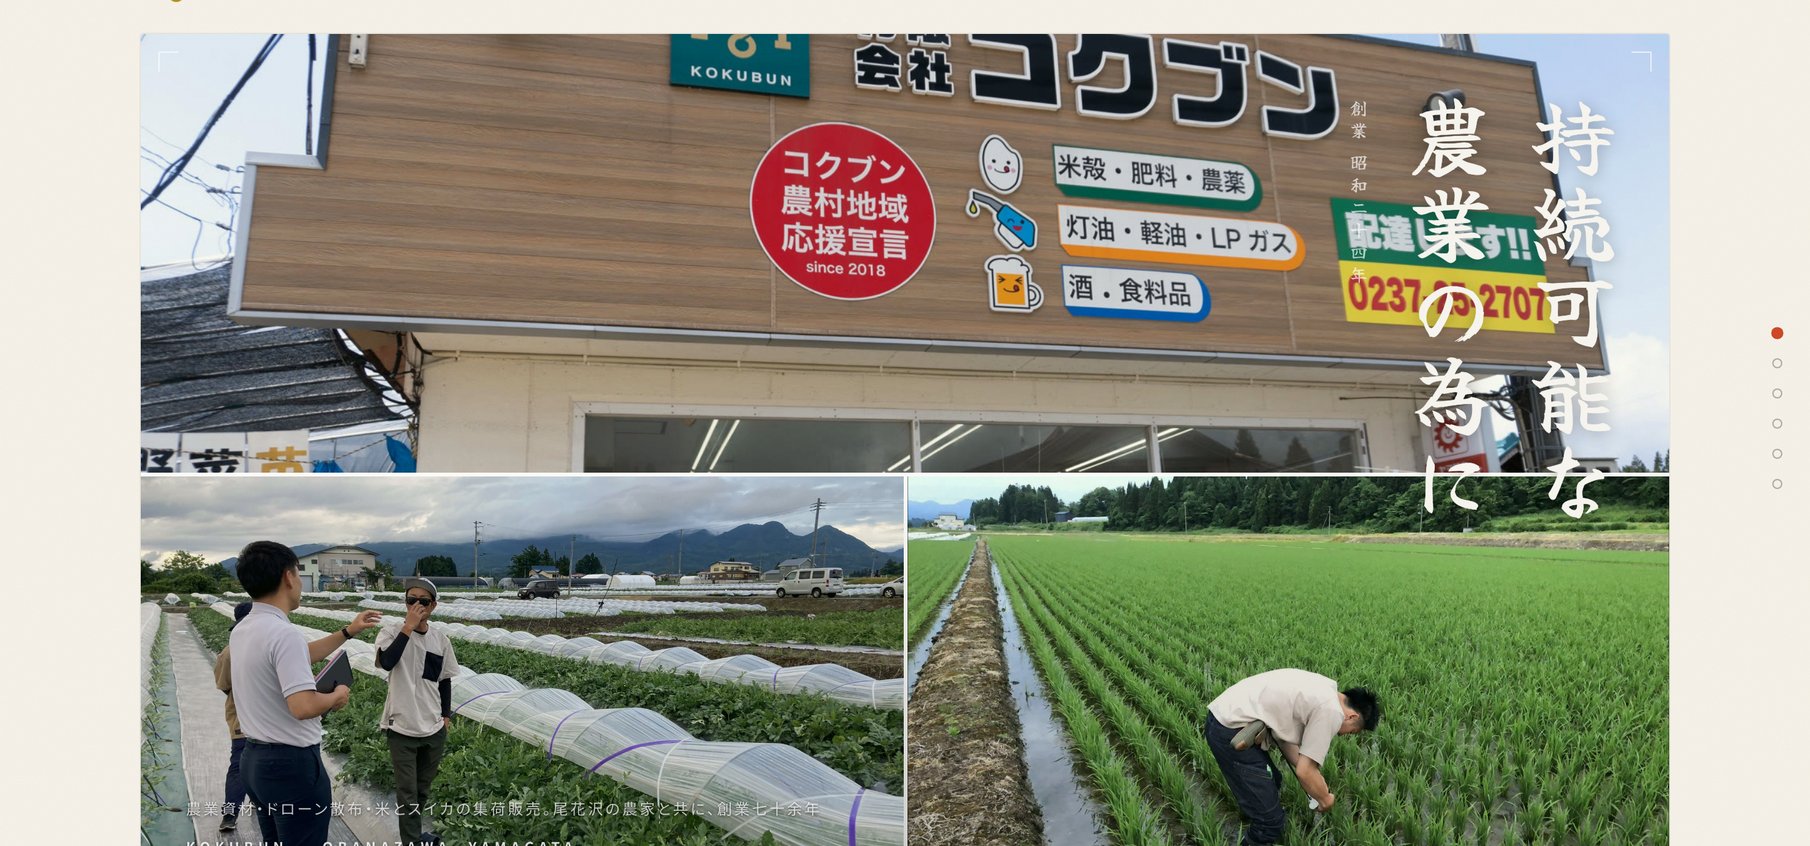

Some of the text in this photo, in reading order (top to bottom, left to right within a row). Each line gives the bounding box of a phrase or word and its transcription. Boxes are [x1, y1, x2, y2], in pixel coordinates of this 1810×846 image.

[690, 65, 792, 87] KOKUBUN
[968, 34, 1340, 140] コクブン
[783, 150, 906, 184] コクブン
[781, 184, 910, 224] 農村地域
[781, 221, 909, 260] 応援宣言
[1344, 211, 1532, 261] 配達しす!!
[806, 260, 886, 277] since 2018
[1069, 273, 1192, 307] 酒・食料品
